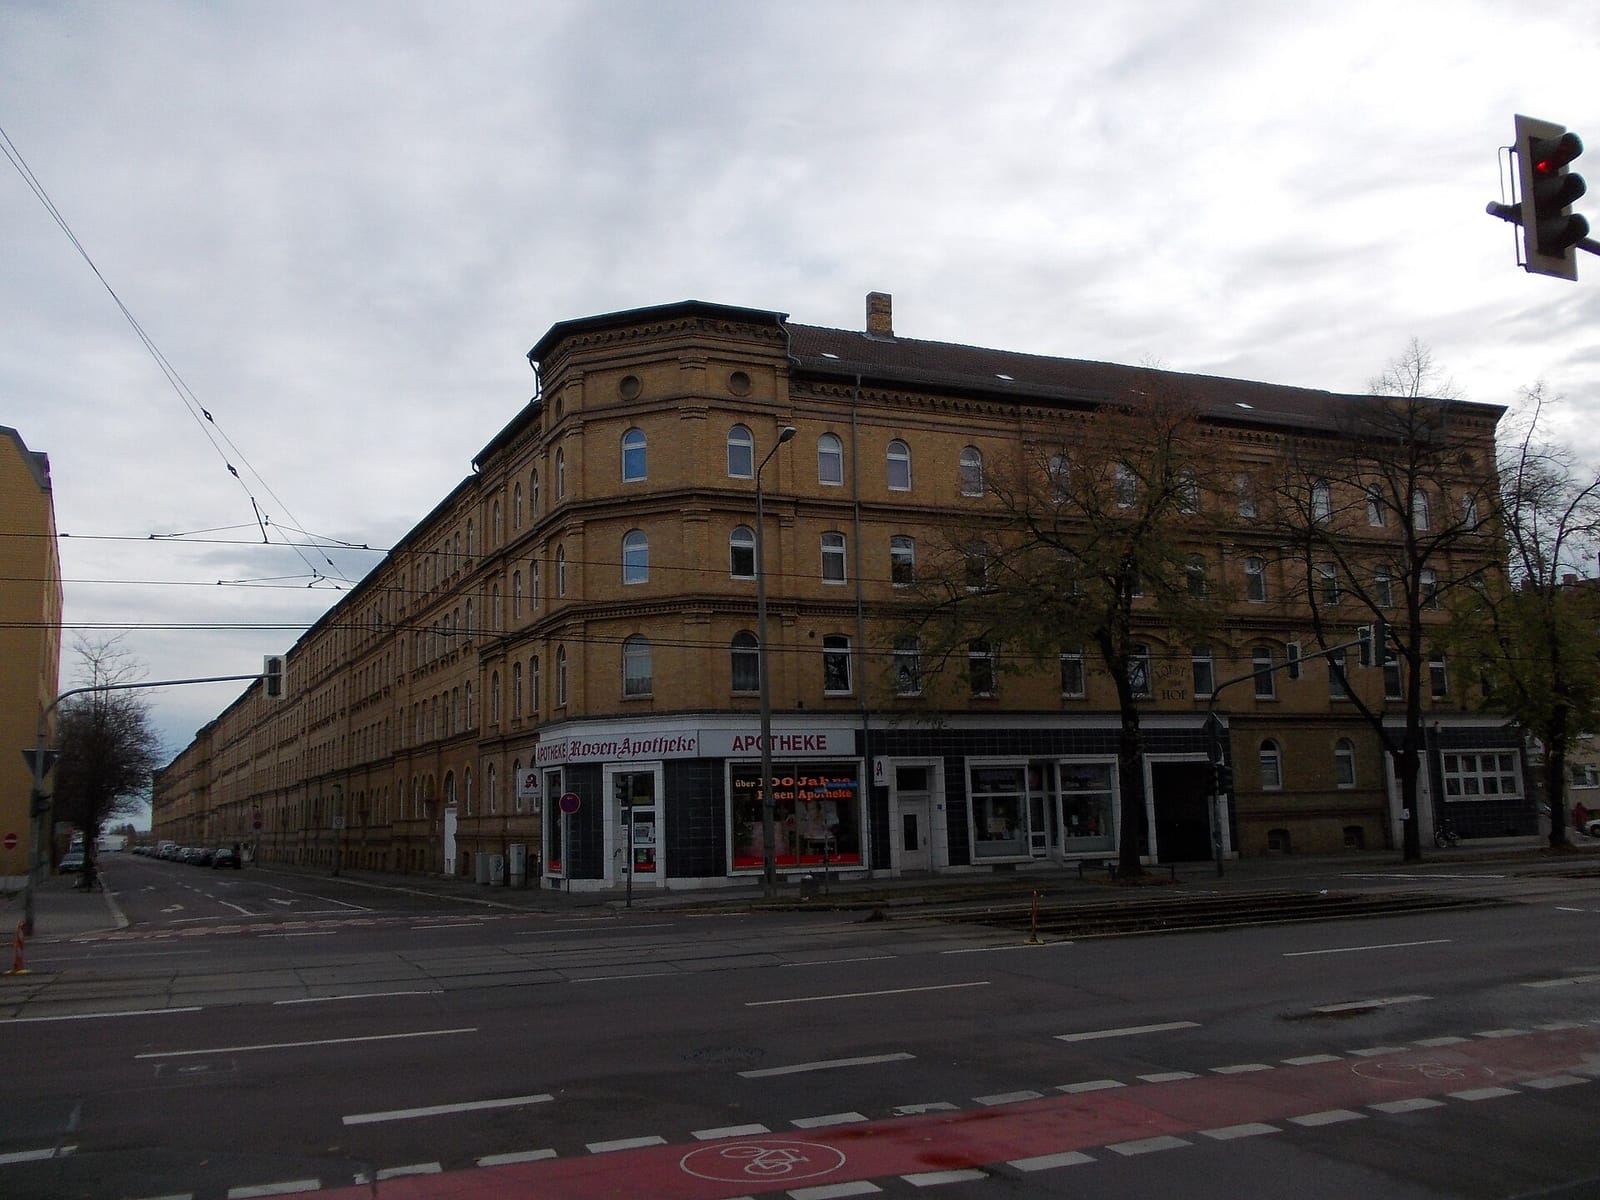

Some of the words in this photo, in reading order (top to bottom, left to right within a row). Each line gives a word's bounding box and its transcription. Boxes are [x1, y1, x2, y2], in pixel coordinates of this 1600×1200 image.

[536, 742, 567, 762] APOTHEKE
[568, 735, 697, 761] Rosen-Apotheke
[735, 779, 756, 788] über
[756, 790, 794, 800] Rsen
